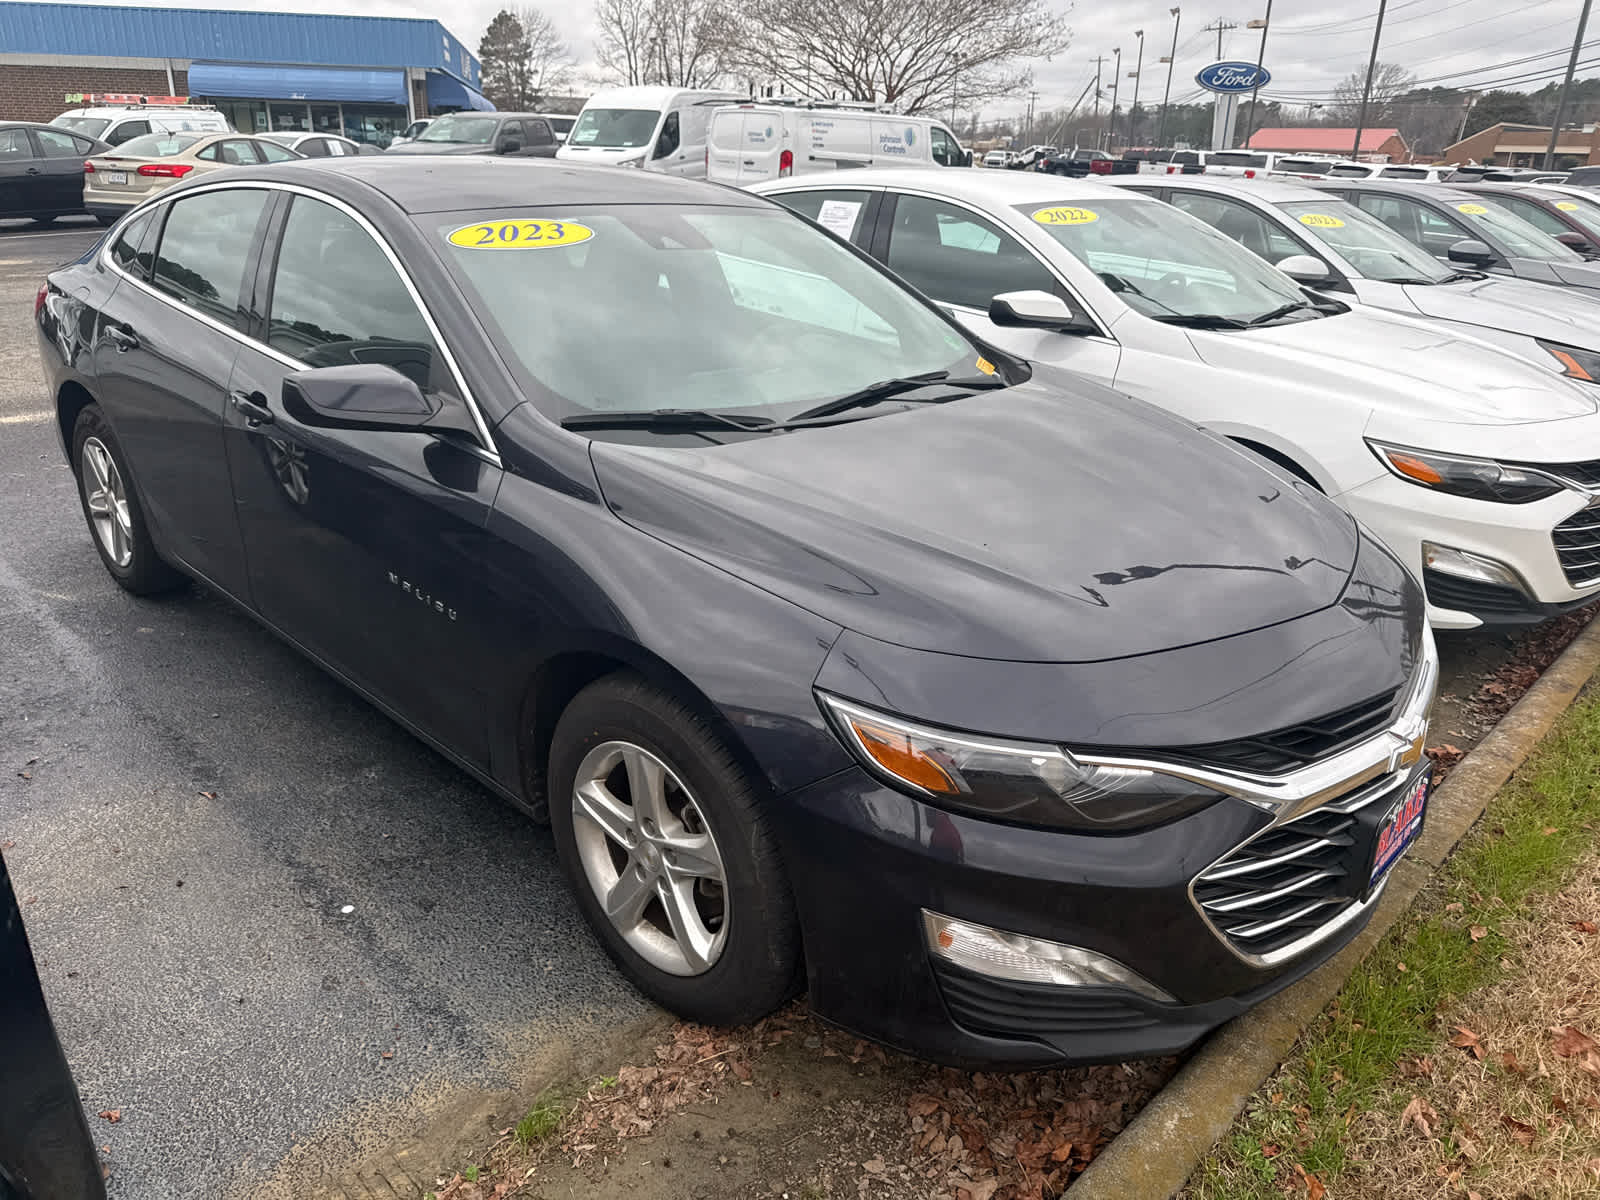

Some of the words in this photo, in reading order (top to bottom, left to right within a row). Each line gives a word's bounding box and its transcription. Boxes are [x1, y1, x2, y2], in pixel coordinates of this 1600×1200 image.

[1212, 66, 1258, 86] Ford
[882, 143, 907, 154] Controls
[1043, 209, 1088, 223] 2022
[474, 222, 566, 245] 2023
[388, 571, 457, 621] MALIBU
